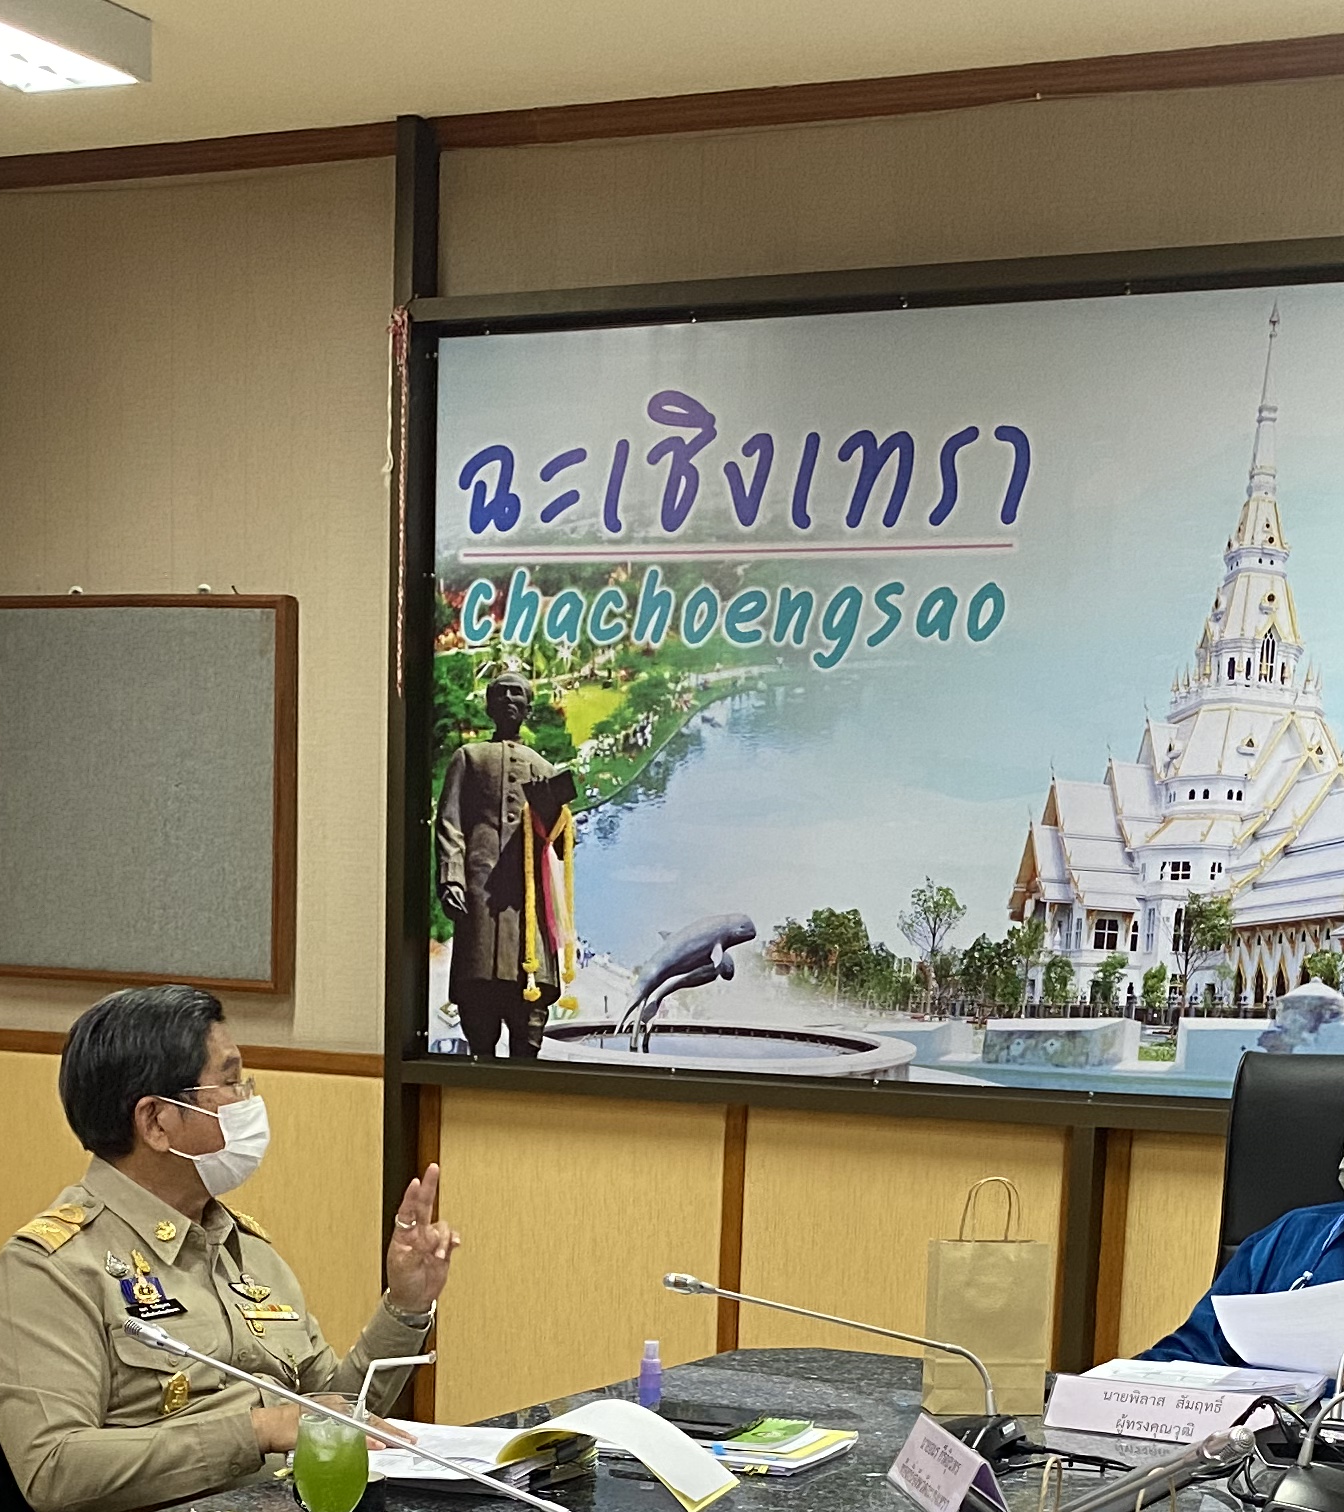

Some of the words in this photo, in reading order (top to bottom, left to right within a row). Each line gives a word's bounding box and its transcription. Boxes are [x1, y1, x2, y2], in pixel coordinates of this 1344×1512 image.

[459, 390, 1031, 534] ฉะเชิงเทรา
[1103, 1390, 1166, 1407] นายพิลาส
